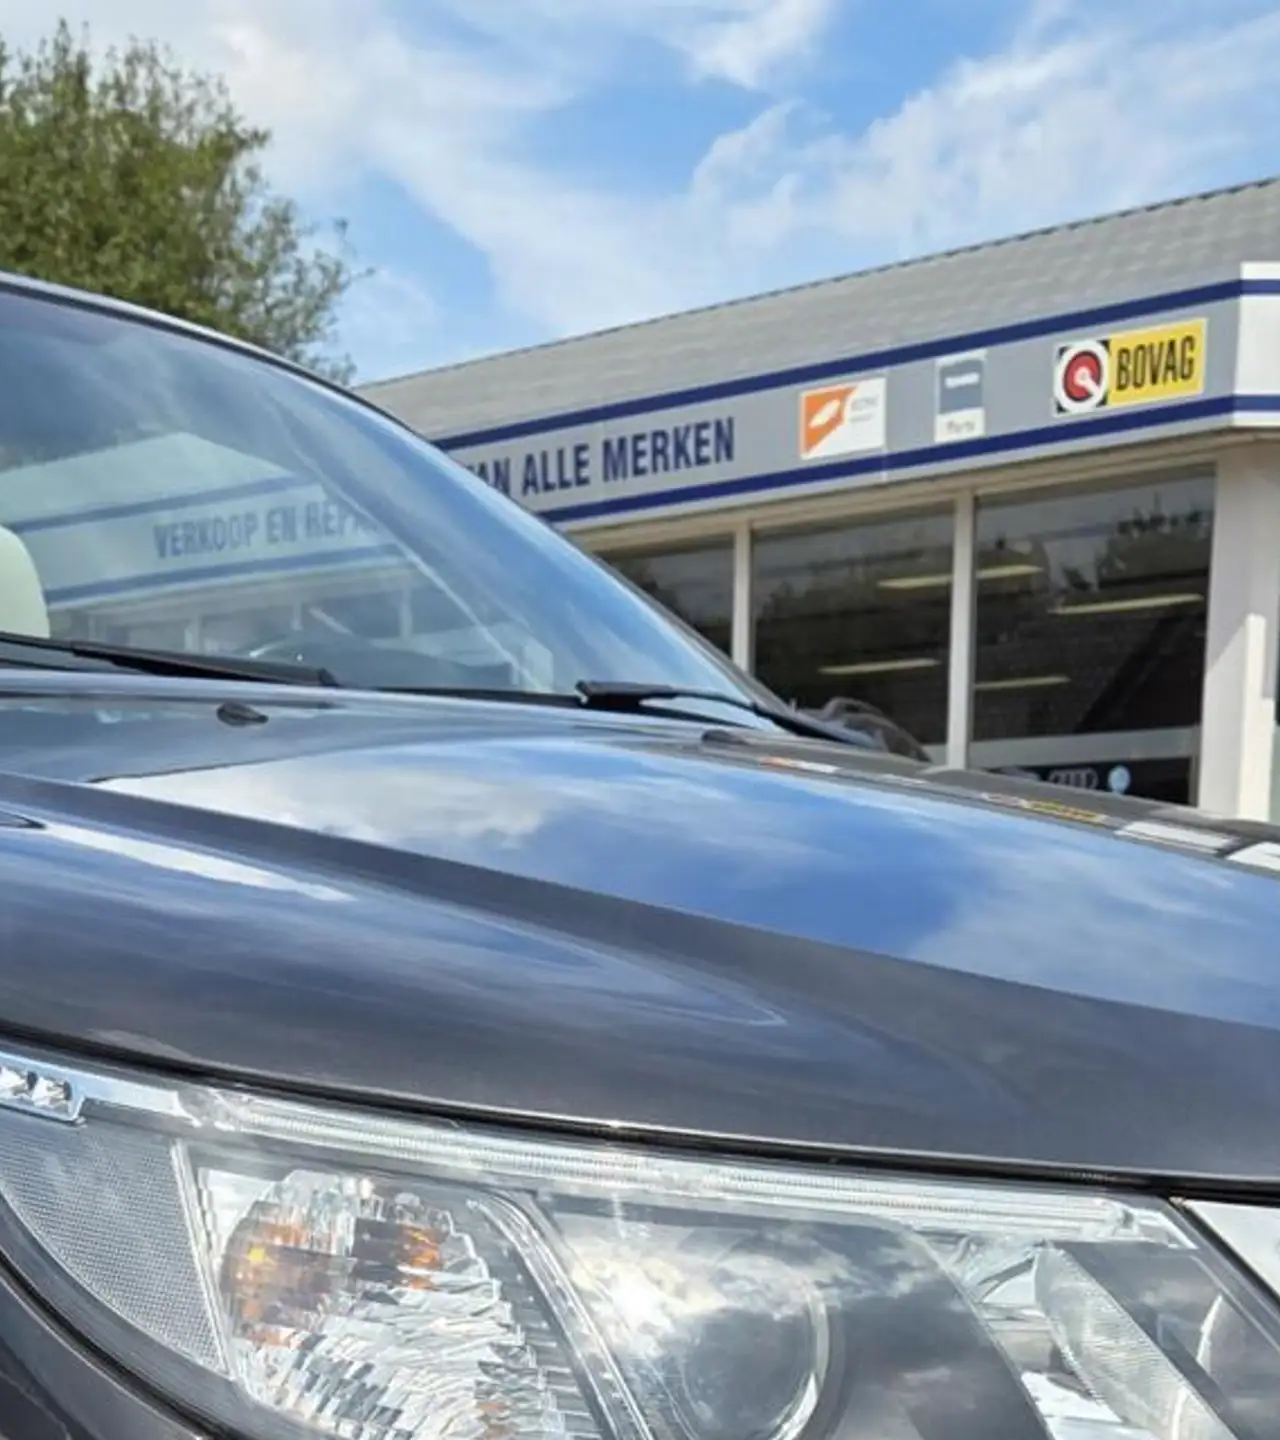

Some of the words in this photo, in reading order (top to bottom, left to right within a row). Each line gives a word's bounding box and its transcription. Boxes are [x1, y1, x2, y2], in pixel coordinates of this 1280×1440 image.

[1116, 335, 1195, 393] BOVAG
[466, 456, 511, 496] AN
[522, 444, 591, 497] ALLE
[602, 416, 735, 483] MERKEN
[154, 510, 258, 559] VERKOOP
[266, 506, 297, 543] EN
